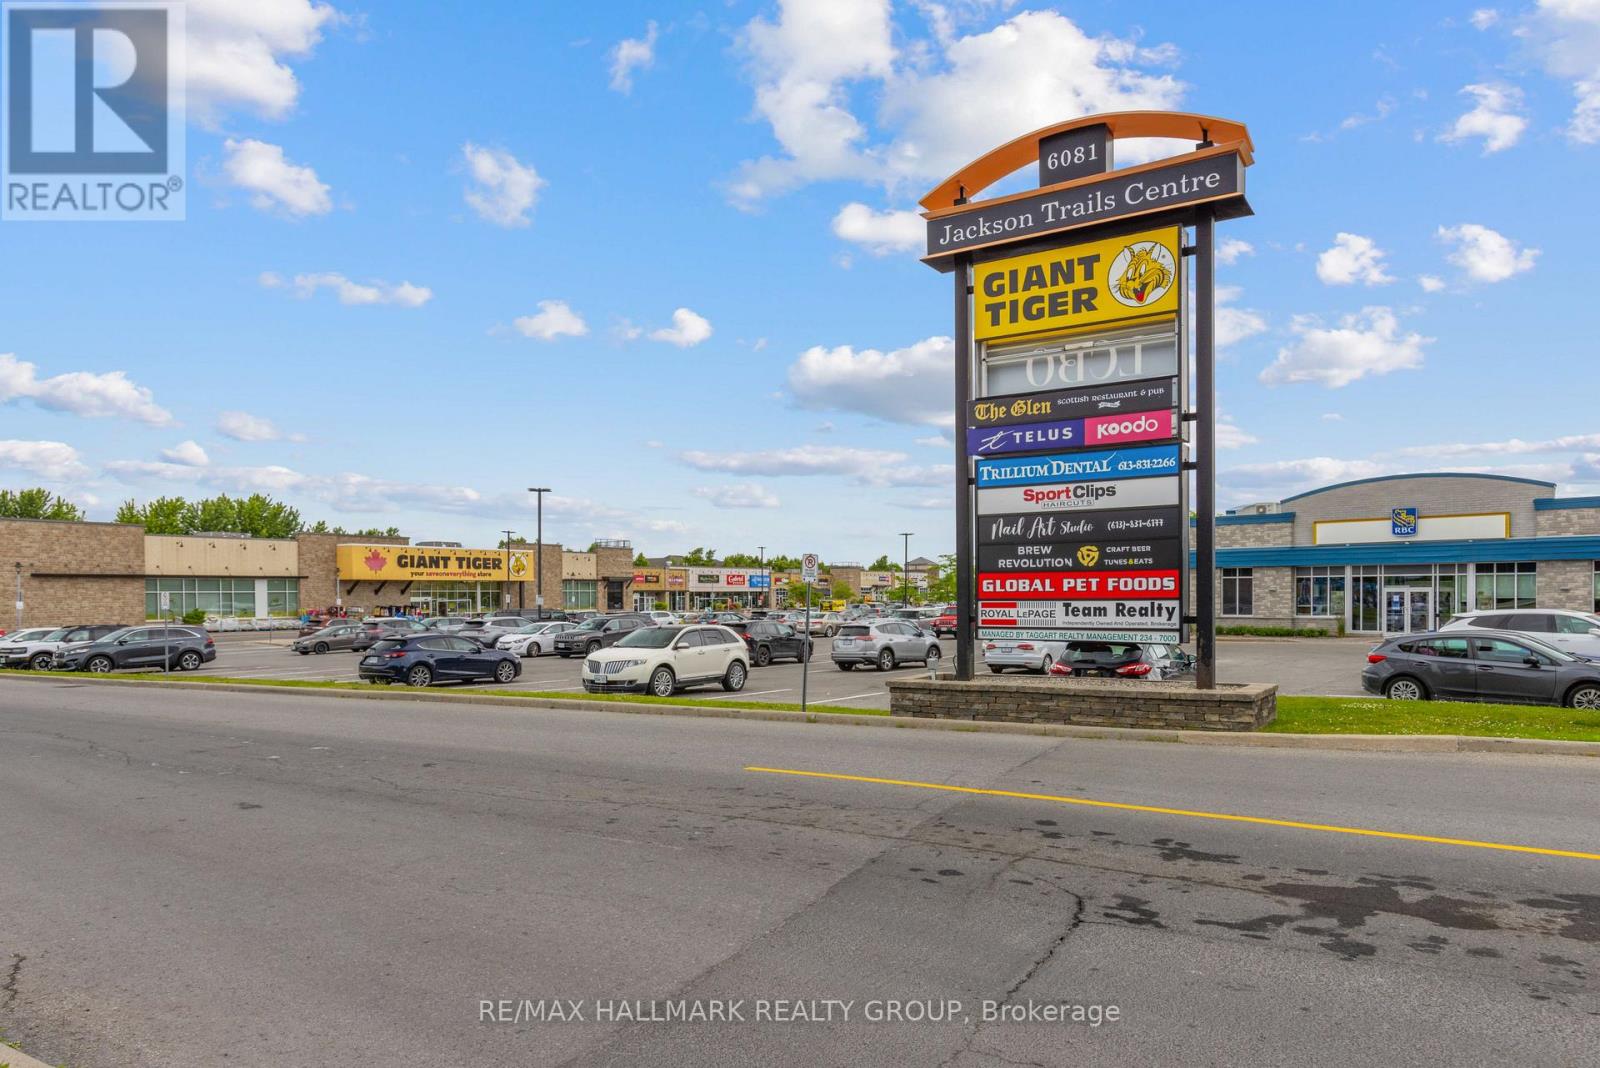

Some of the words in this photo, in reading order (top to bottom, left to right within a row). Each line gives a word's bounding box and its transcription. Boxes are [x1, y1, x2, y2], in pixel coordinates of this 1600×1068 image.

[1047, 144, 1098, 170] 6081
[939, 211, 1033, 246] Jackson
[1041, 192, 1116, 223] Trails
[1124, 172, 1221, 205] Centre
[983, 254, 1100, 297] GIANT
[985, 286, 1099, 327] TIGER
[974, 402, 1006, 422] The
[1010, 399, 1052, 417] Glen
[1013, 427, 1073, 444] TELUS
[980, 464, 1049, 481] TRILLIUM
[1051, 460, 1111, 476] DENTAL
[1117, 457, 1176, 471] 613-831-2266
[1042, 500, 1093, 508] HAIRCUTS
[991, 517, 1025, 540] Nail
[1027, 516, 1056, 539] Art
[1059, 520, 1094, 535] Studio
[1394, 526, 1415, 534] RBC
[1017, 546, 1053, 555] BREW
[396, 554, 451, 569] GIANT
[455, 556, 503, 570] TIGER
[998, 557, 1073, 569] REVOLUTION
[982, 578, 1055, 592] GLOBAL
[1062, 578, 1099, 592] PET
[1107, 577, 1175, 591] FOODS
[980, 610, 1014, 618] ROYAL
[1062, 602, 1107, 618] Team
[1115, 602, 1177, 621] Realty
[981, 630, 1015, 638] MANAGED
[1026, 631, 1057, 639] TAGGART
[1058, 632, 1085, 640] REALTY
[1086, 632, 1138, 641] MANAGEMENT
[1139, 633, 1153, 641] 234
[1159, 634, 1177, 642] 7000
